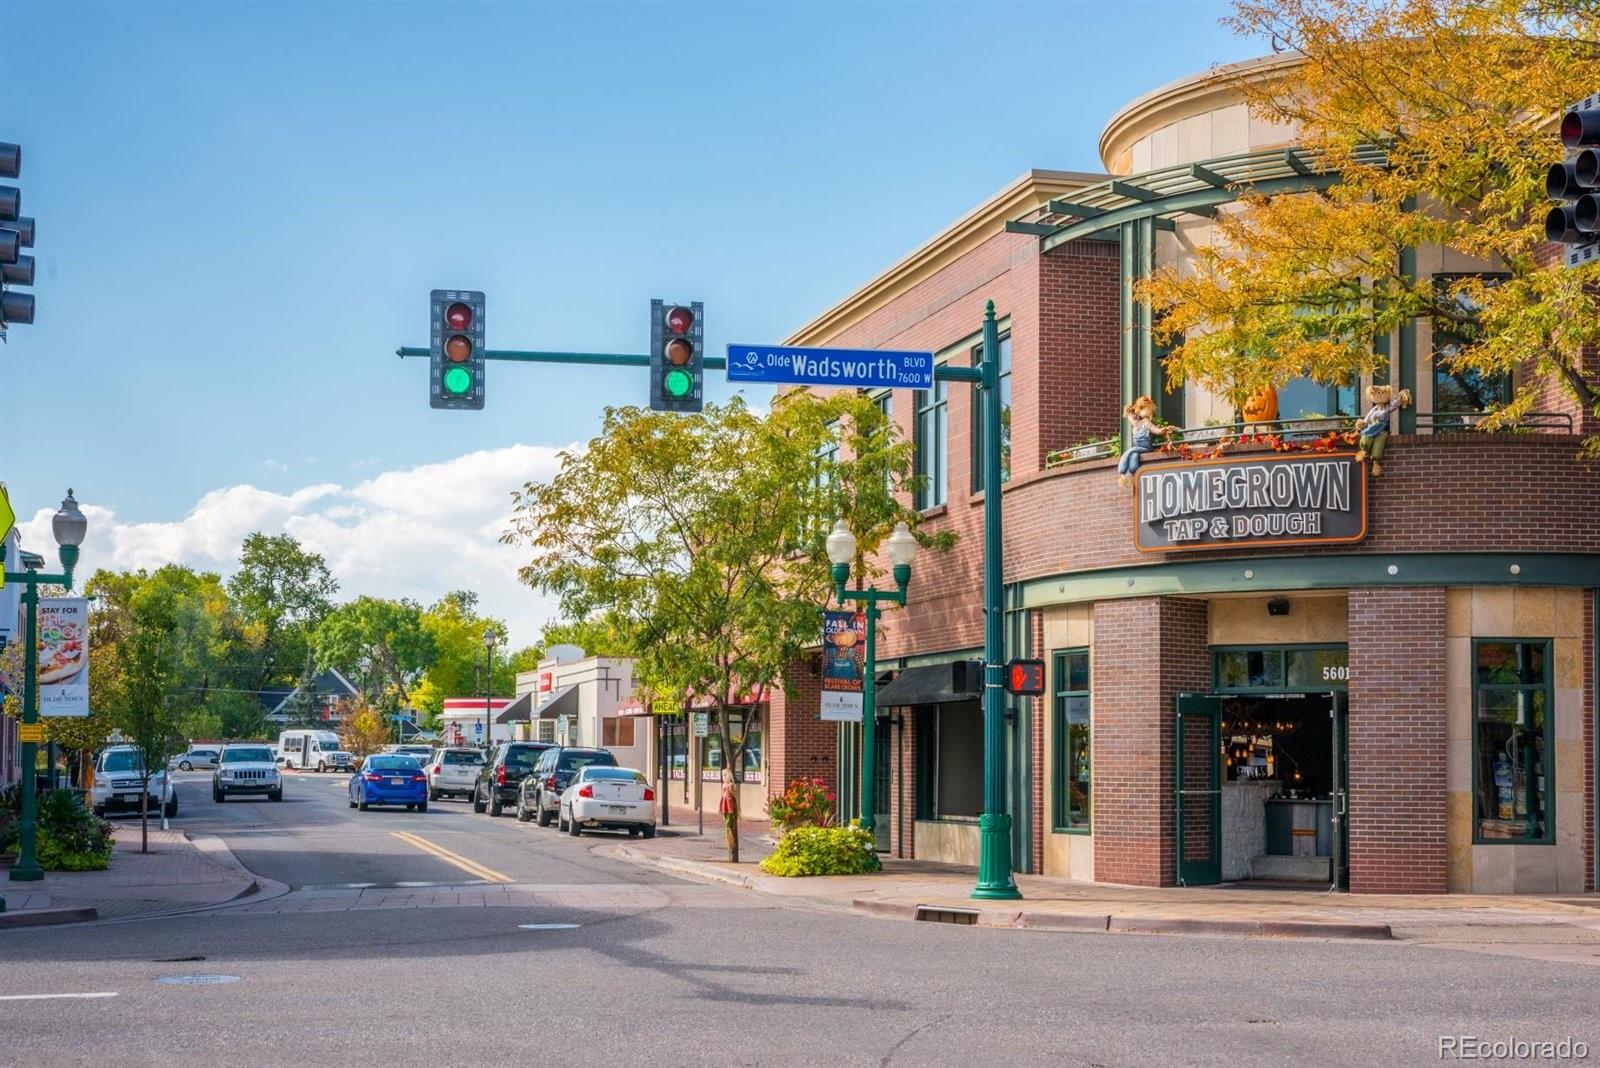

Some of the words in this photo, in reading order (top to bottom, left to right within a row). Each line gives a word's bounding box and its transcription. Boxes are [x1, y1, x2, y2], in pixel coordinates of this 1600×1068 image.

[767, 353, 790, 367] Olde
[792, 354, 897, 380] Wadsworth
[903, 357, 925, 369] BLVD
[898, 371, 921, 384] 7600
[923, 373, 932, 383] W
[1140, 461, 1351, 524] HOMEGROWN
[1163, 517, 1209, 542] TAP
[1209, 516, 1230, 539] &
[1232, 511, 1321, 537] DOUGH
[826, 619, 848, 628] FALL
[853, 621, 864, 629] IN
[42, 626, 84, 640] FOOD
[1322, 667, 1350, 680] 5601
[824, 677, 851, 686] FESTIVAL
